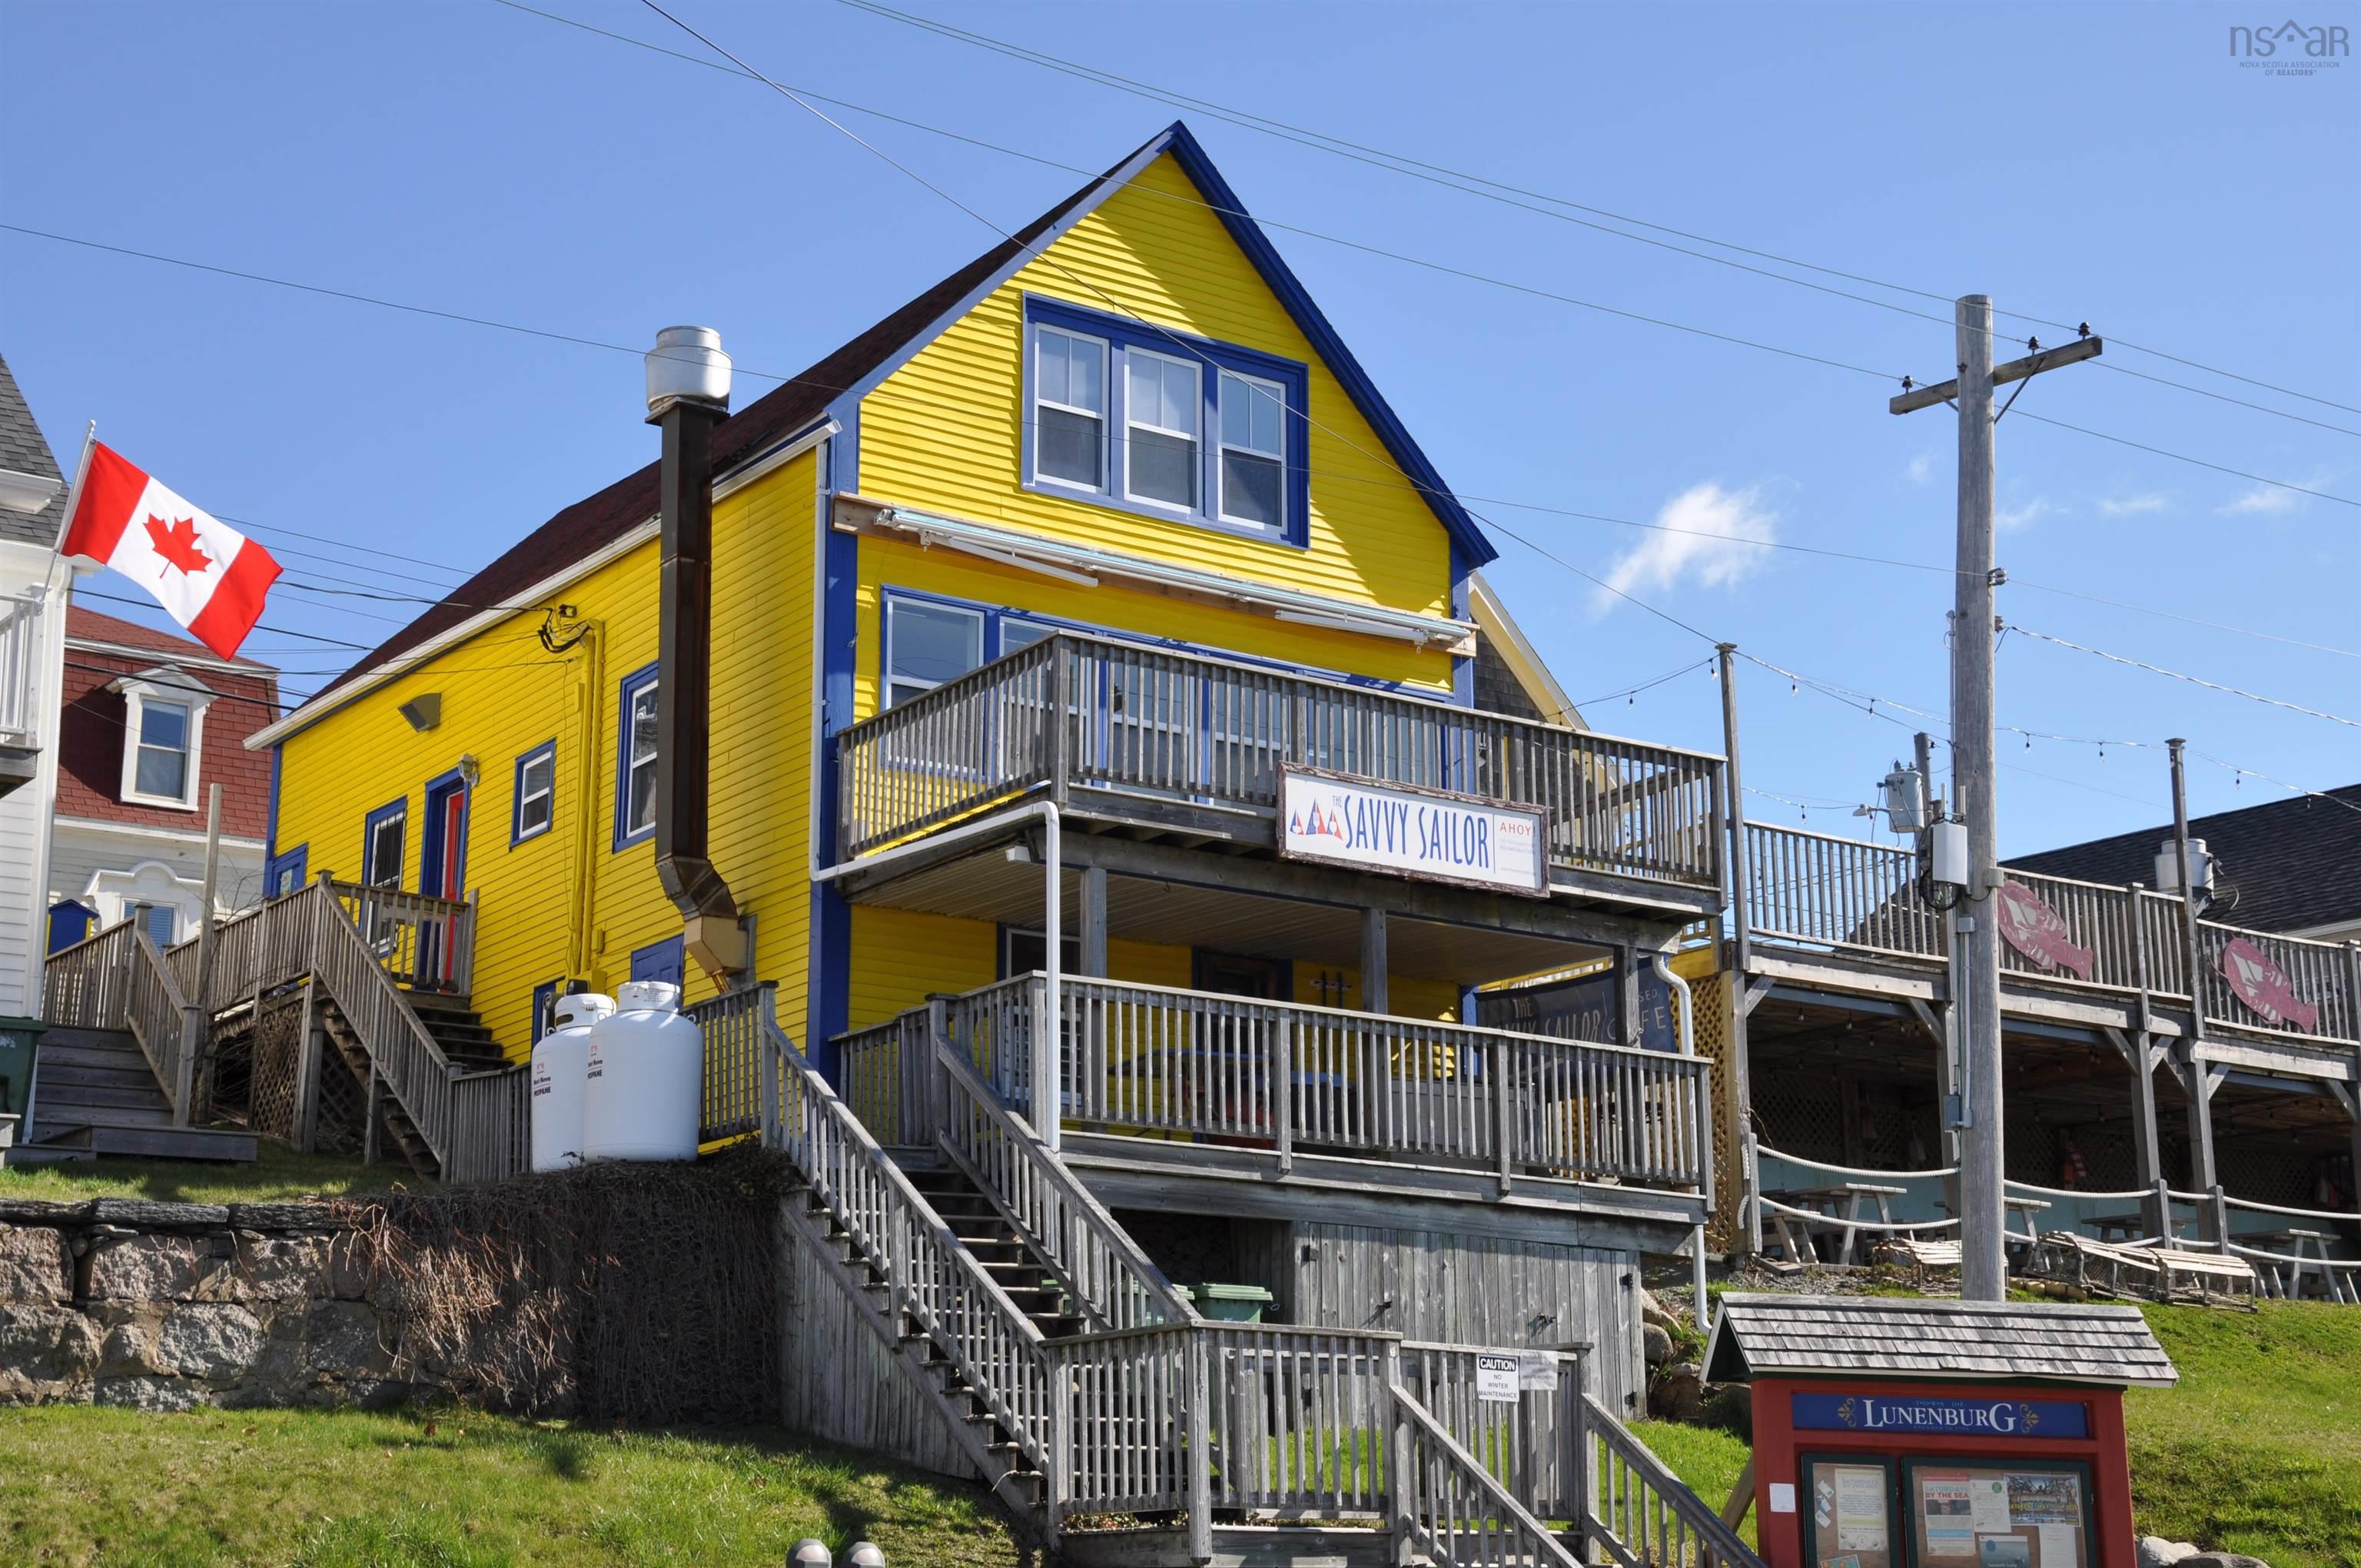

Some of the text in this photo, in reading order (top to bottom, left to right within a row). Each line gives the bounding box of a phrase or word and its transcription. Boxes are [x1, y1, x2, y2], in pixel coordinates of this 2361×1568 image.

[1333, 794, 1489, 869] THE SAVVY SAILOR
[1512, 997, 1534, 1019] THE
[1607, 1006, 1666, 1041] CFE
[1480, 1358, 1516, 1370] CAUTION
[1479, 1390, 1517, 1399] MAINTENANCE
[1863, 1400, 2017, 1432] LUNENBURG
